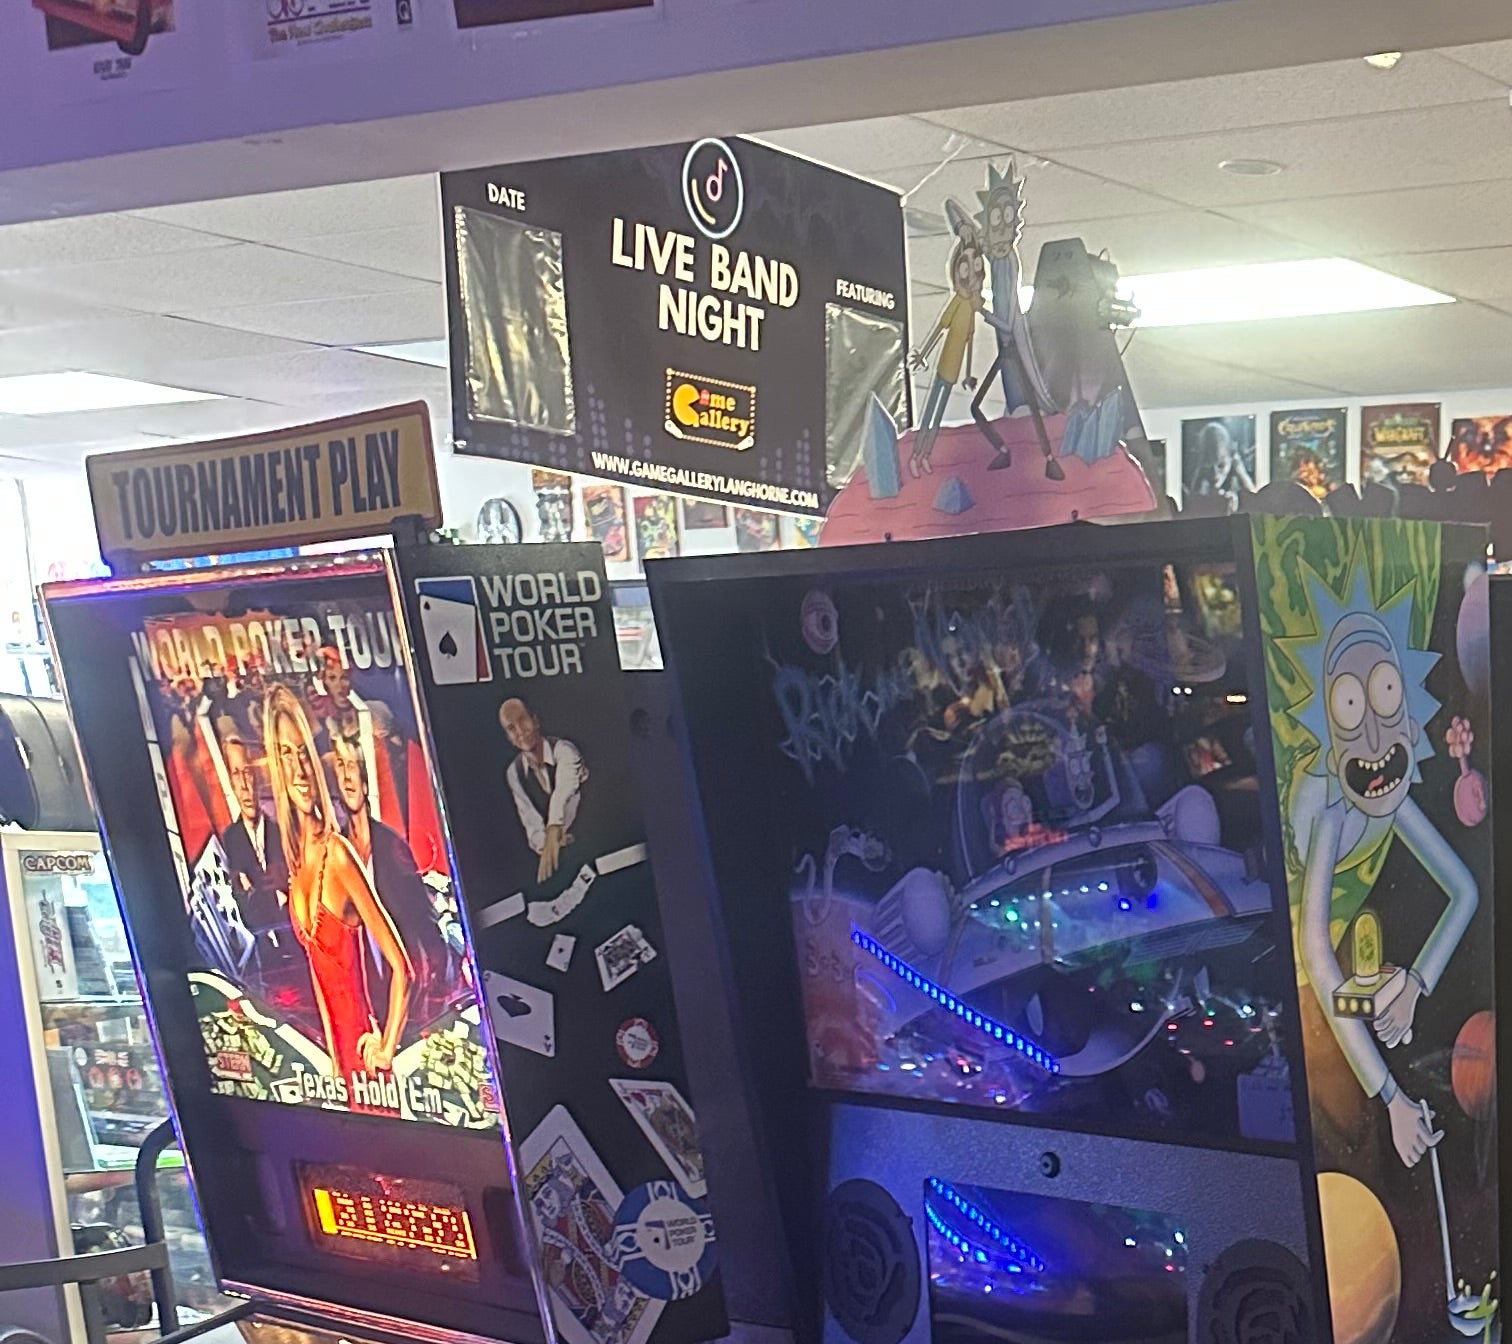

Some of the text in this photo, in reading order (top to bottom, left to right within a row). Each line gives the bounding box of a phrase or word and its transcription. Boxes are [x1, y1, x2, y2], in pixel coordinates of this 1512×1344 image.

[487, 182, 526, 211] DATE
[612, 217, 799, 308] LIVE BAND
[836, 279, 895, 310] FEATURING
[658, 284, 765, 351] NIGHT
[112, 429, 402, 541] TOURNAMENT PLAY
[591, 451, 819, 511] WWW.GAMEGALLERYLANGHORNE.COM
[481, 571, 602, 608] WORLD
[491, 608, 598, 643] POKER
[131, 611, 405, 683] WORLD POKER TOU
[493, 642, 583, 679] TOUR
[24, 855, 92, 872] CAPCOM
[291, 1061, 348, 1102] Texas
[352, 1070, 400, 1110] Hold
[668, 1226, 698, 1239] POKER
